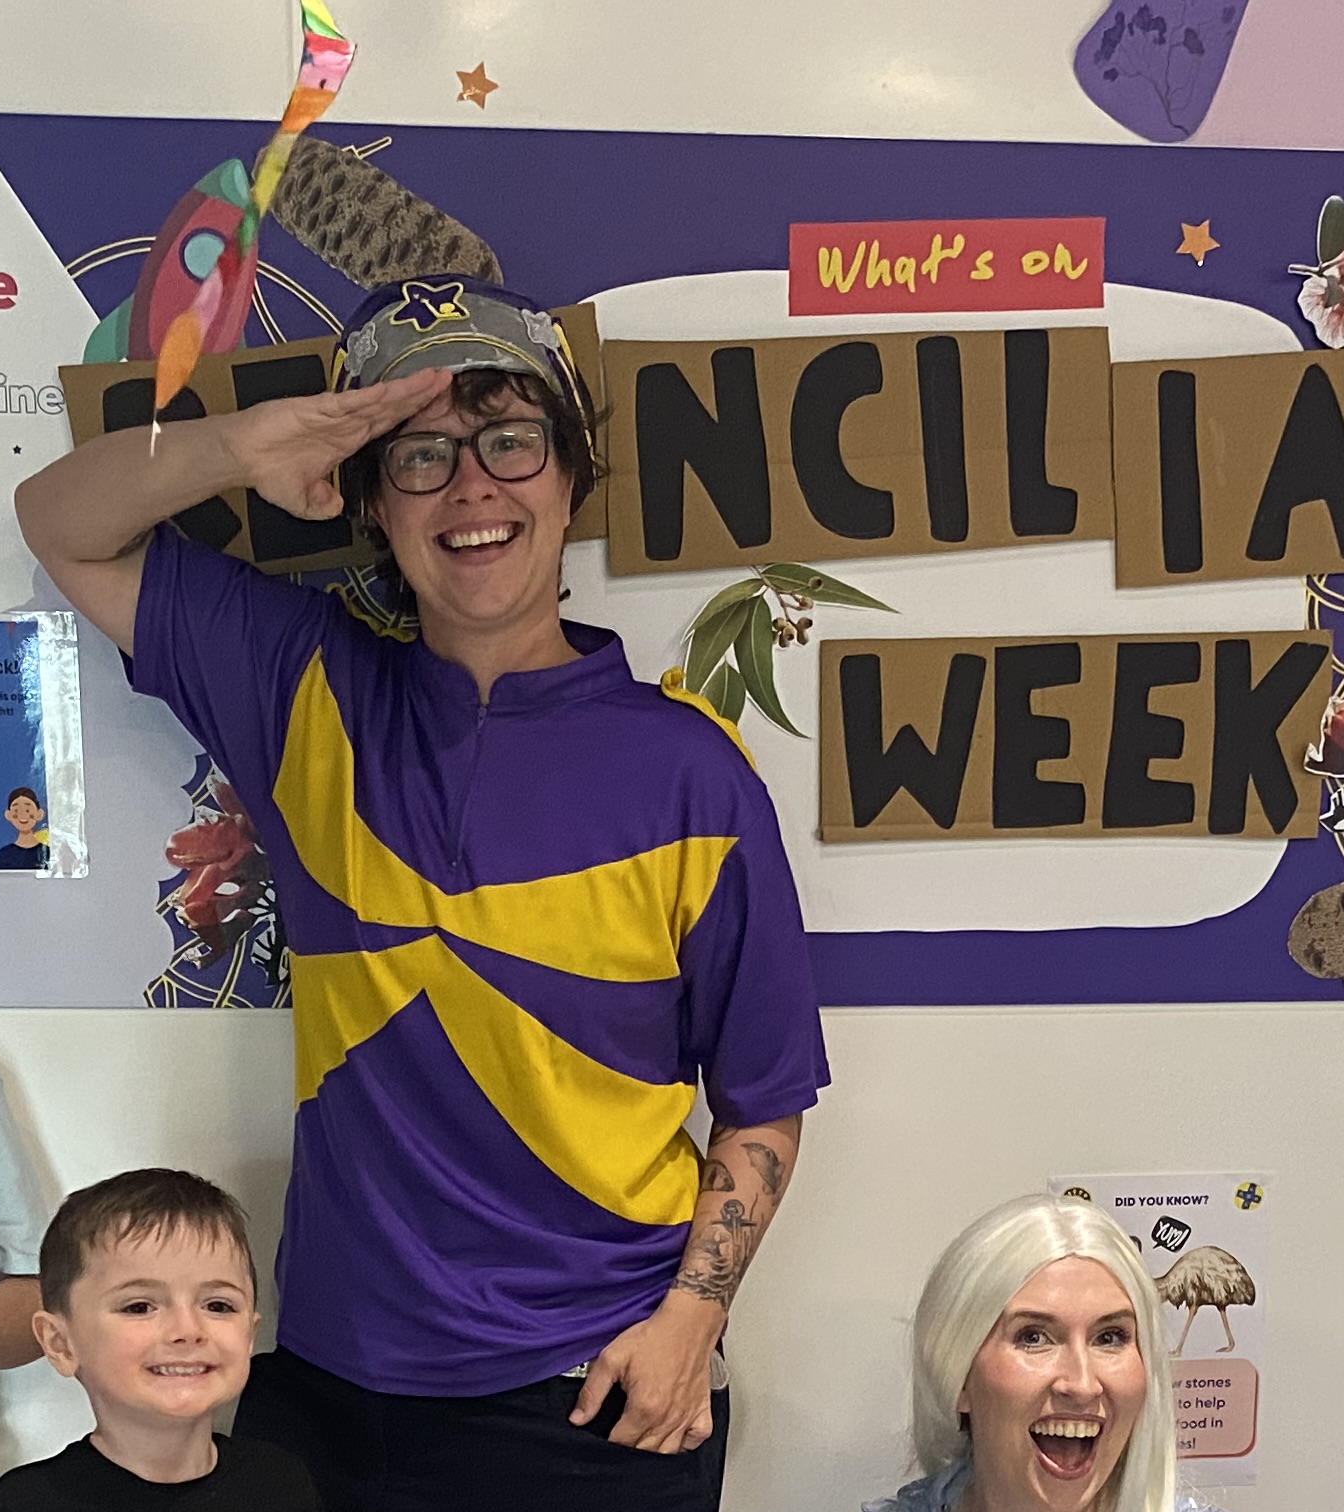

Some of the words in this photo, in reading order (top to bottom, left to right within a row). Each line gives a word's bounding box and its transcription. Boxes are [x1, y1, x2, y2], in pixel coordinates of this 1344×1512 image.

[817, 236, 995, 293] What's
[1021, 249, 1088, 281] on
[0, 691, 9, 701] is
[839, 639, 1330, 834] WEEK
[1115, 1197, 1136, 1207] DID
[1138, 1196, 1164, 1206] YOU
[1166, 1195, 1209, 1206] KNOW?
[1185, 1378, 1231, 1388] stones
[1178, 1399, 1192, 1409] to
[1195, 1396, 1226, 1410] help
[1211, 1417, 1223, 1428] in
